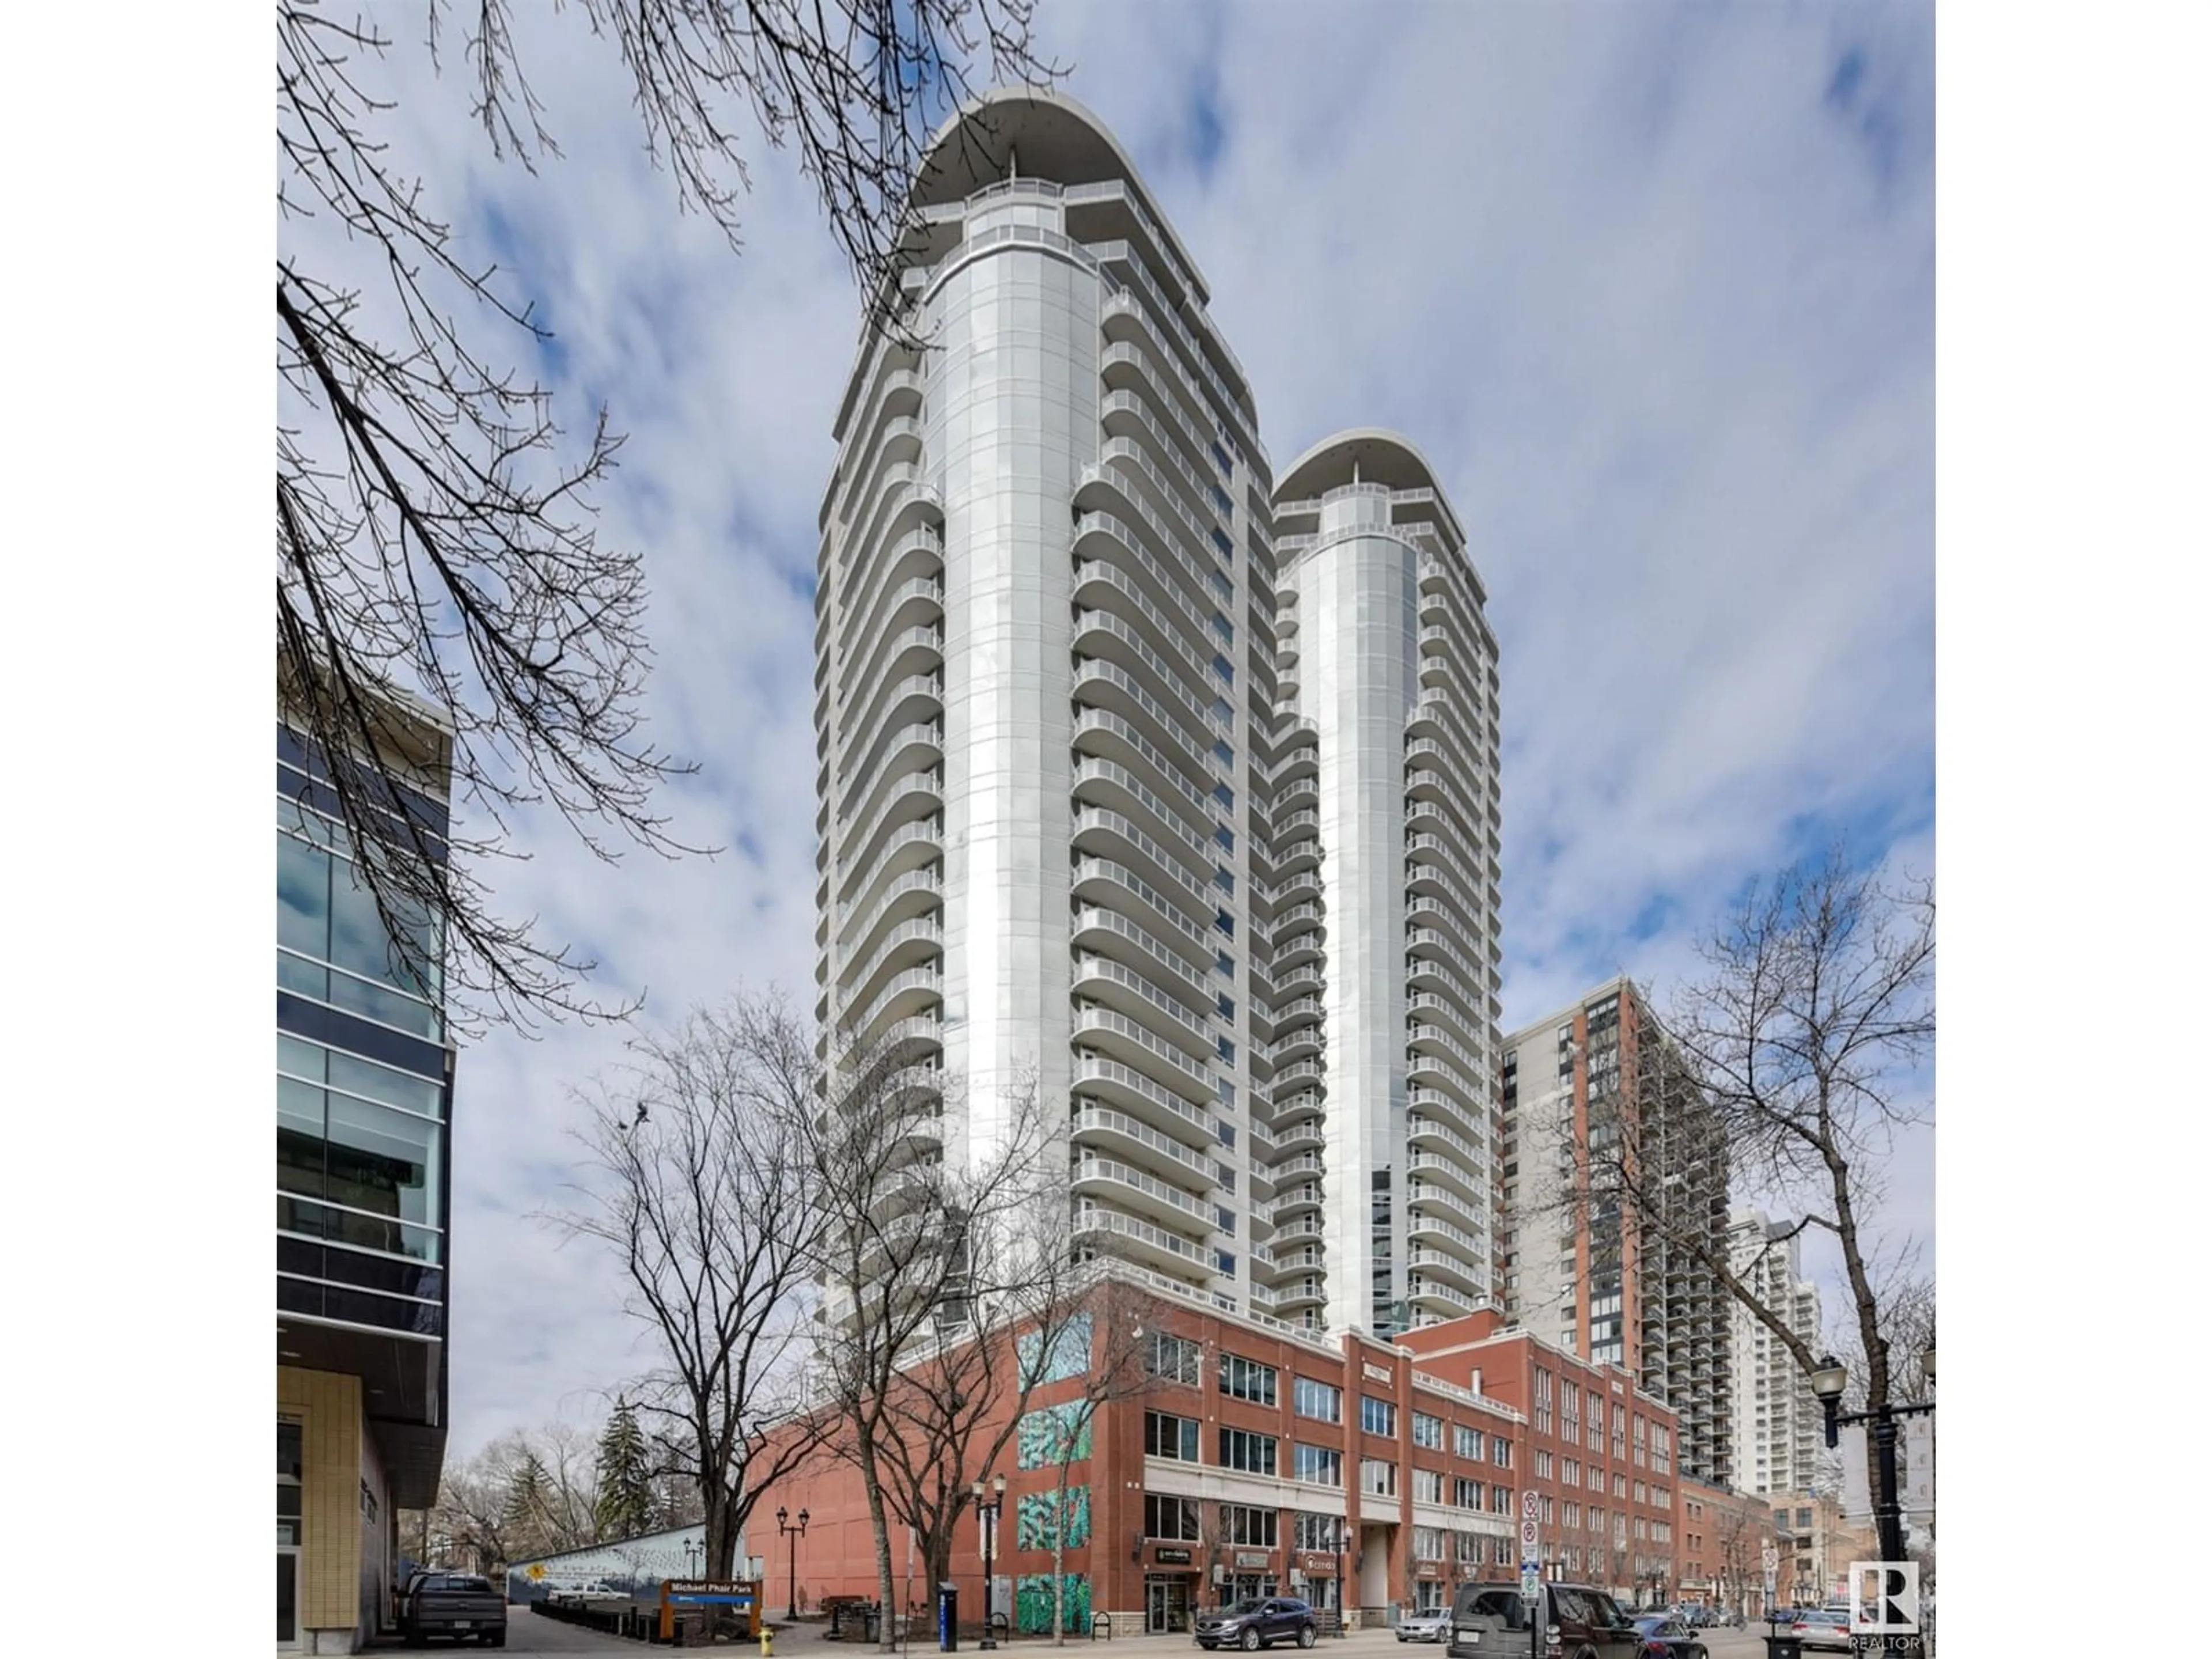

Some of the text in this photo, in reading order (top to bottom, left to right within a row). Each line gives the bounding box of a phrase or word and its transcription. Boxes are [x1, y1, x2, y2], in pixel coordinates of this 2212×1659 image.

[672, 1583, 752, 1593] Michael Phair Park
